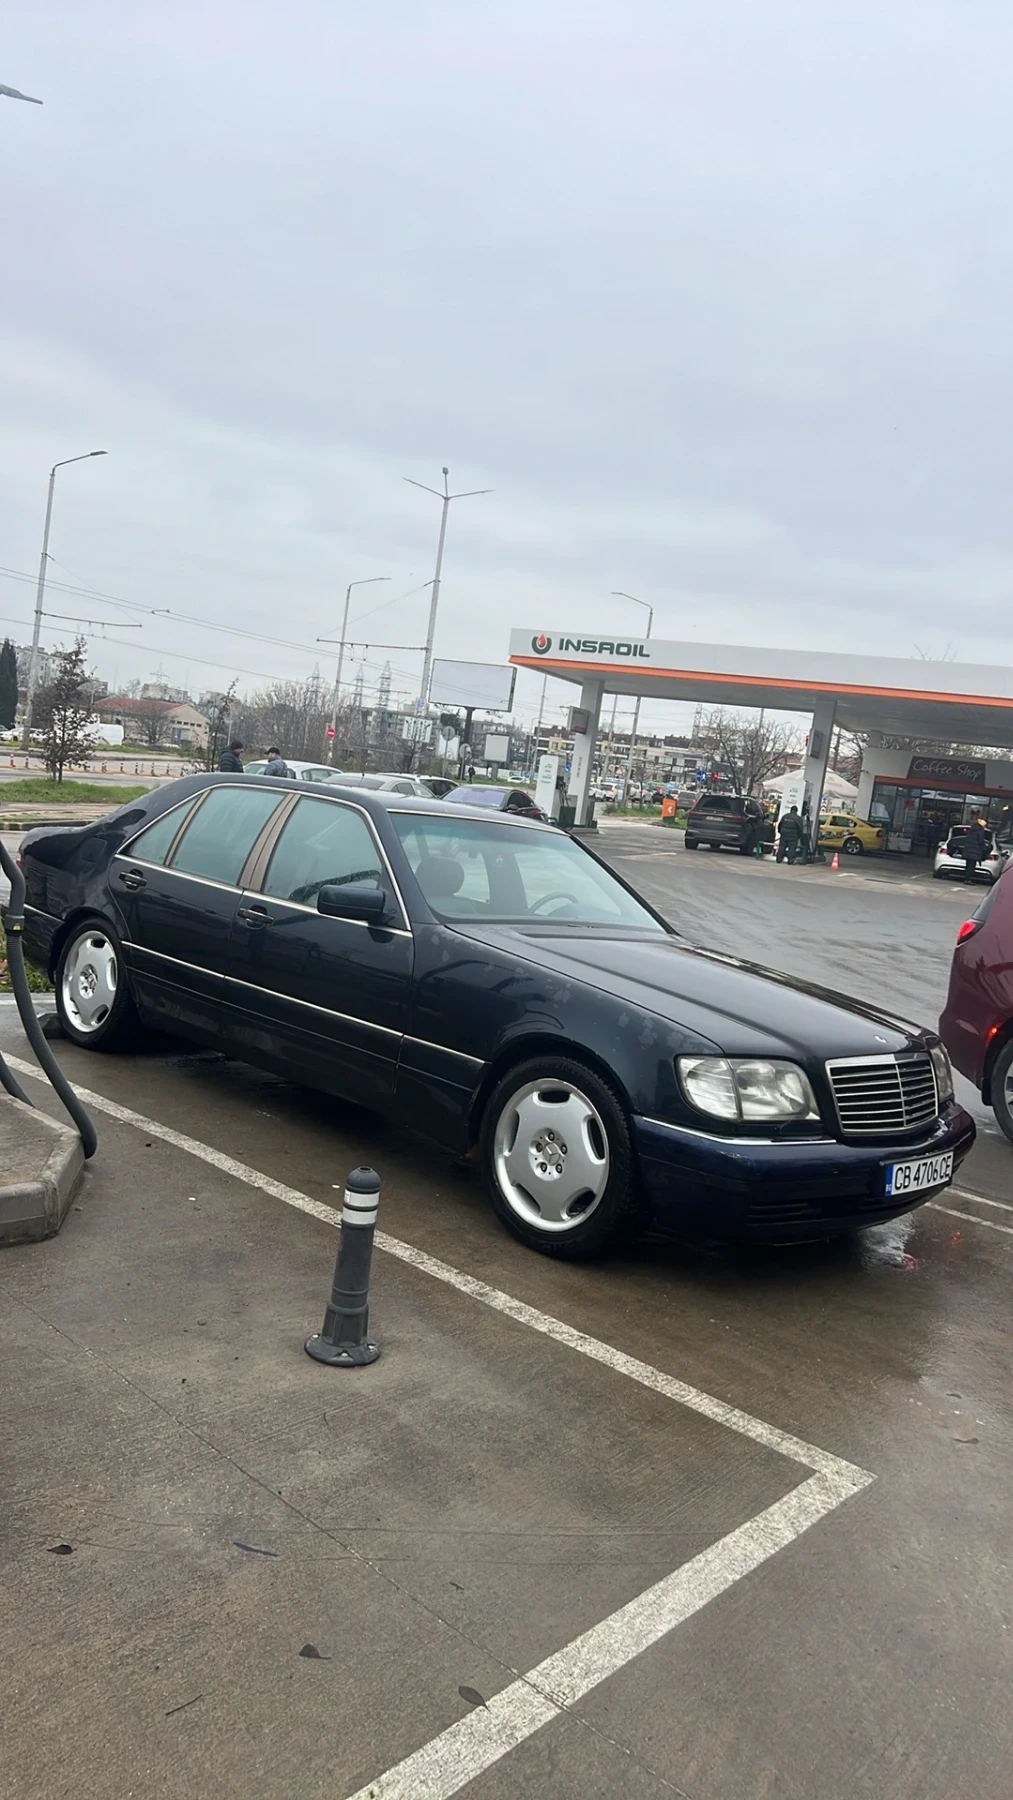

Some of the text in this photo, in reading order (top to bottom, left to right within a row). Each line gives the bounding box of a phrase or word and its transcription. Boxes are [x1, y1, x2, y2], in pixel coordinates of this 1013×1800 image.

[558, 637, 650, 658] INSAOIL
[912, 759, 983, 782] Coffee Shop
[894, 1154, 952, 1191] CB 4706 CE
